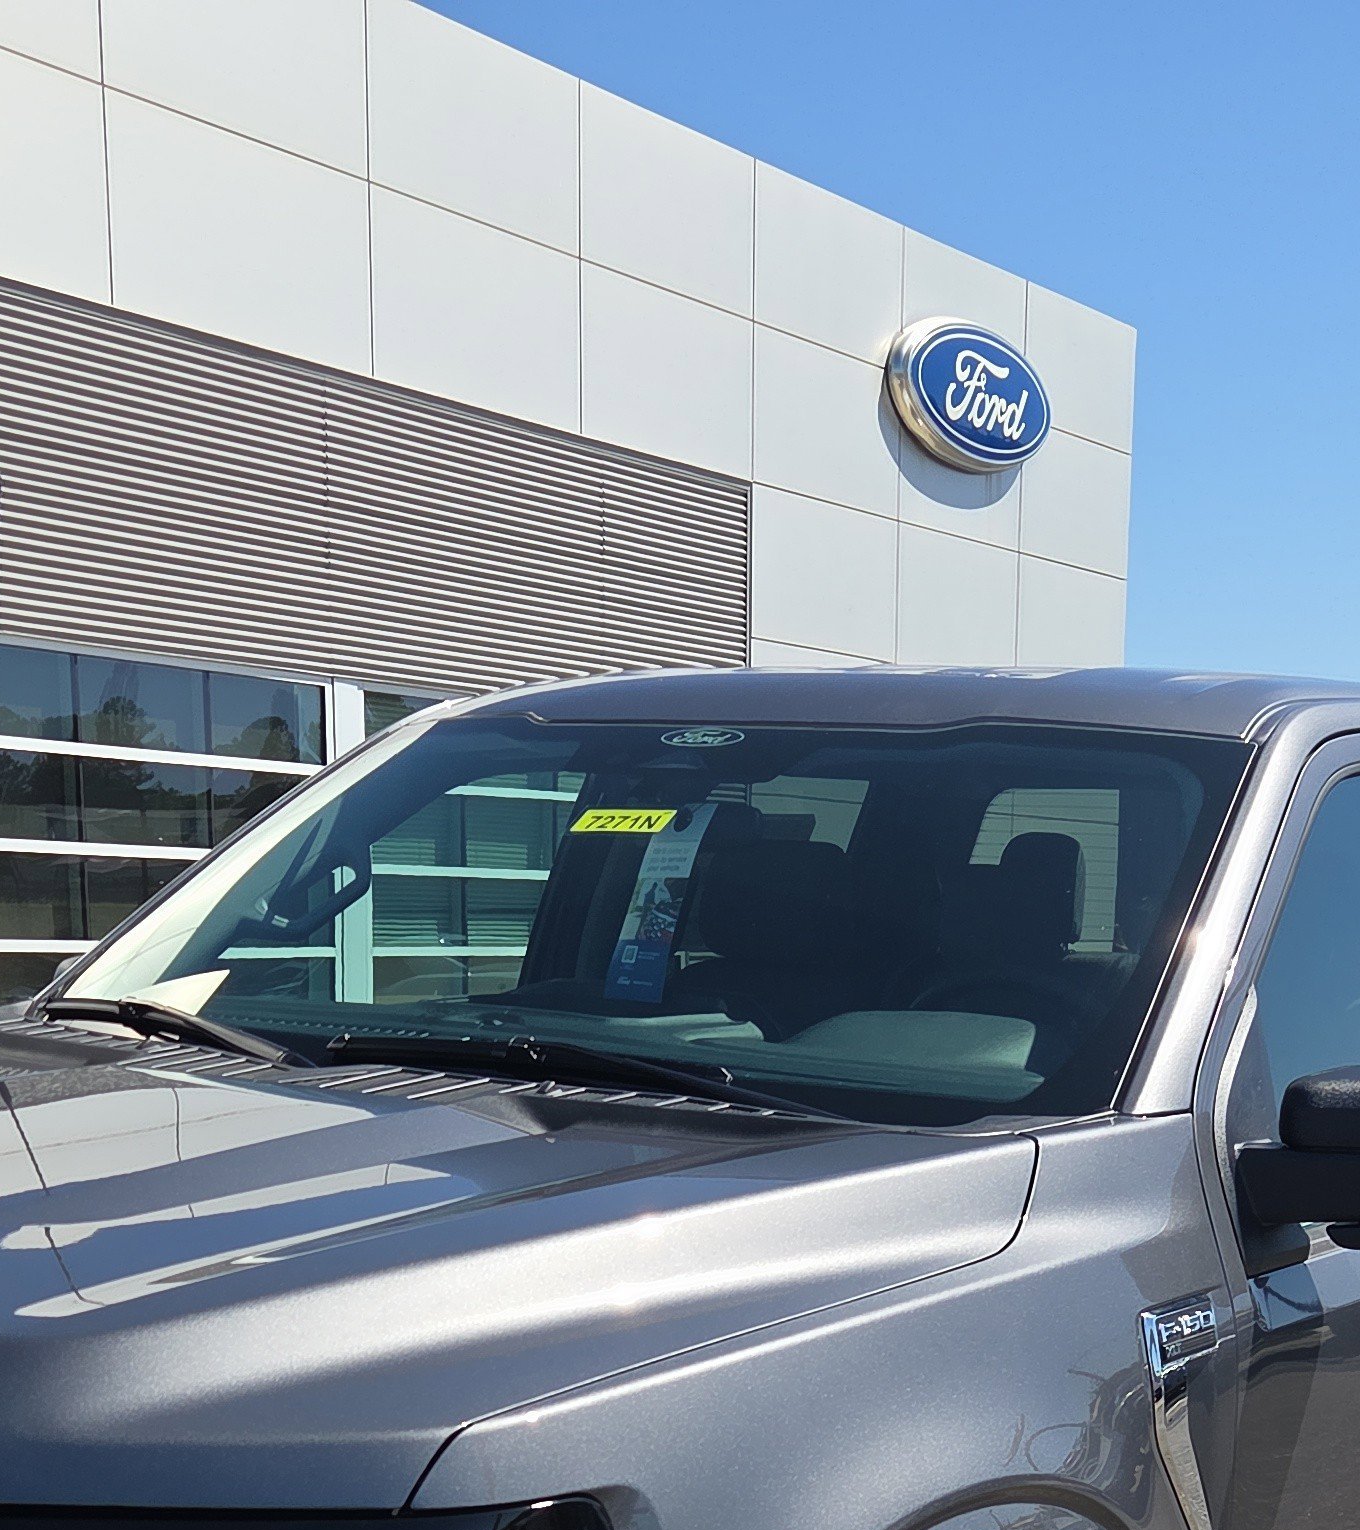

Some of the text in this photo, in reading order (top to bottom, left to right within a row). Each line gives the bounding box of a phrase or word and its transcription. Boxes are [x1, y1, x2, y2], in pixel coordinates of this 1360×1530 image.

[945, 350, 1029, 440] Ford
[672, 730, 732, 745] Ford
[584, 815, 663, 830] 7271N
[1158, 1310, 1216, 1343] F-150
